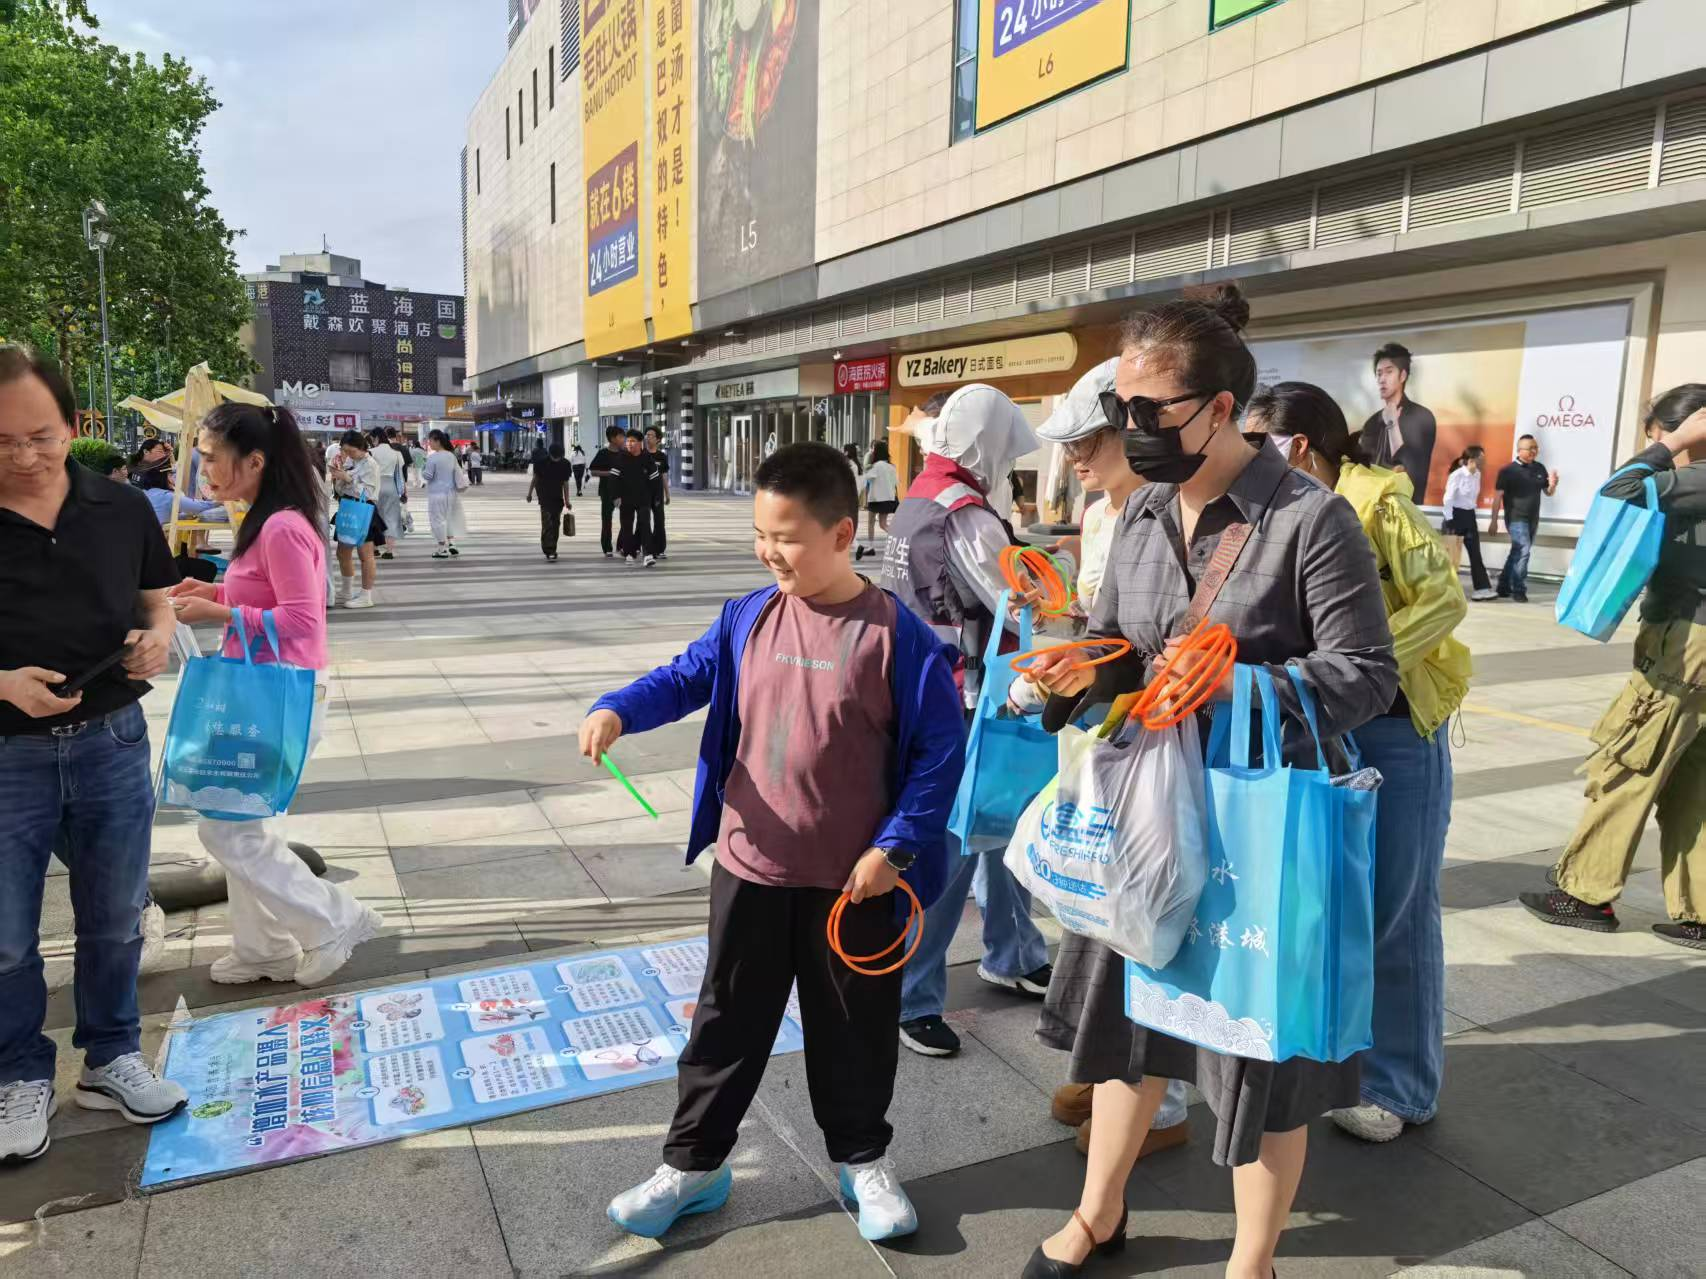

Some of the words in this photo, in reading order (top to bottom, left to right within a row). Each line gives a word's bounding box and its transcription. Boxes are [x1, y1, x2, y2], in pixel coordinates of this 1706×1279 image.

[1038, 53, 1054, 79] L6
[585, 86, 604, 123] BANU
[605, 51, 637, 105] HOTPOT
[741, 220, 757, 252] L5
[590, 231, 635, 287] 24小时营业
[303, 314, 431, 337] 戴森欢聚酒店
[906, 360, 921, 378] YZ
[923, 355, 968, 378] Bakery
[1536, 414, 1595, 428] OMEGA
[1212, 859, 1240, 885] 水
